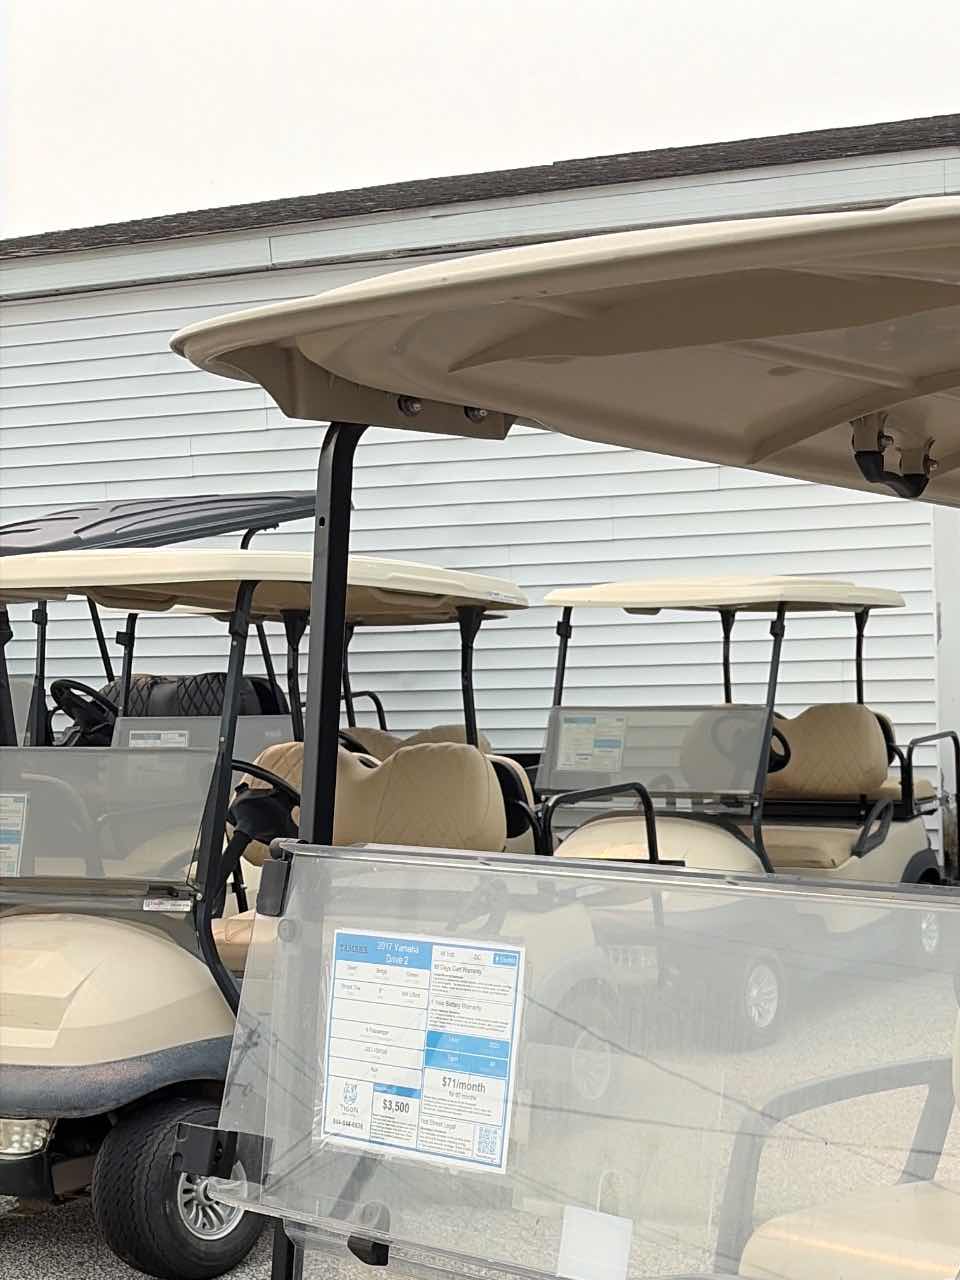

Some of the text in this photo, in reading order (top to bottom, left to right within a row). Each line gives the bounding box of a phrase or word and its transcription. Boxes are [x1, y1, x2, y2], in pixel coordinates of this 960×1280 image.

[394, 942, 420, 954] Yamaha
[441, 1076, 486, 1093] $71/month
[382, 1098, 410, 1113] $3,500
